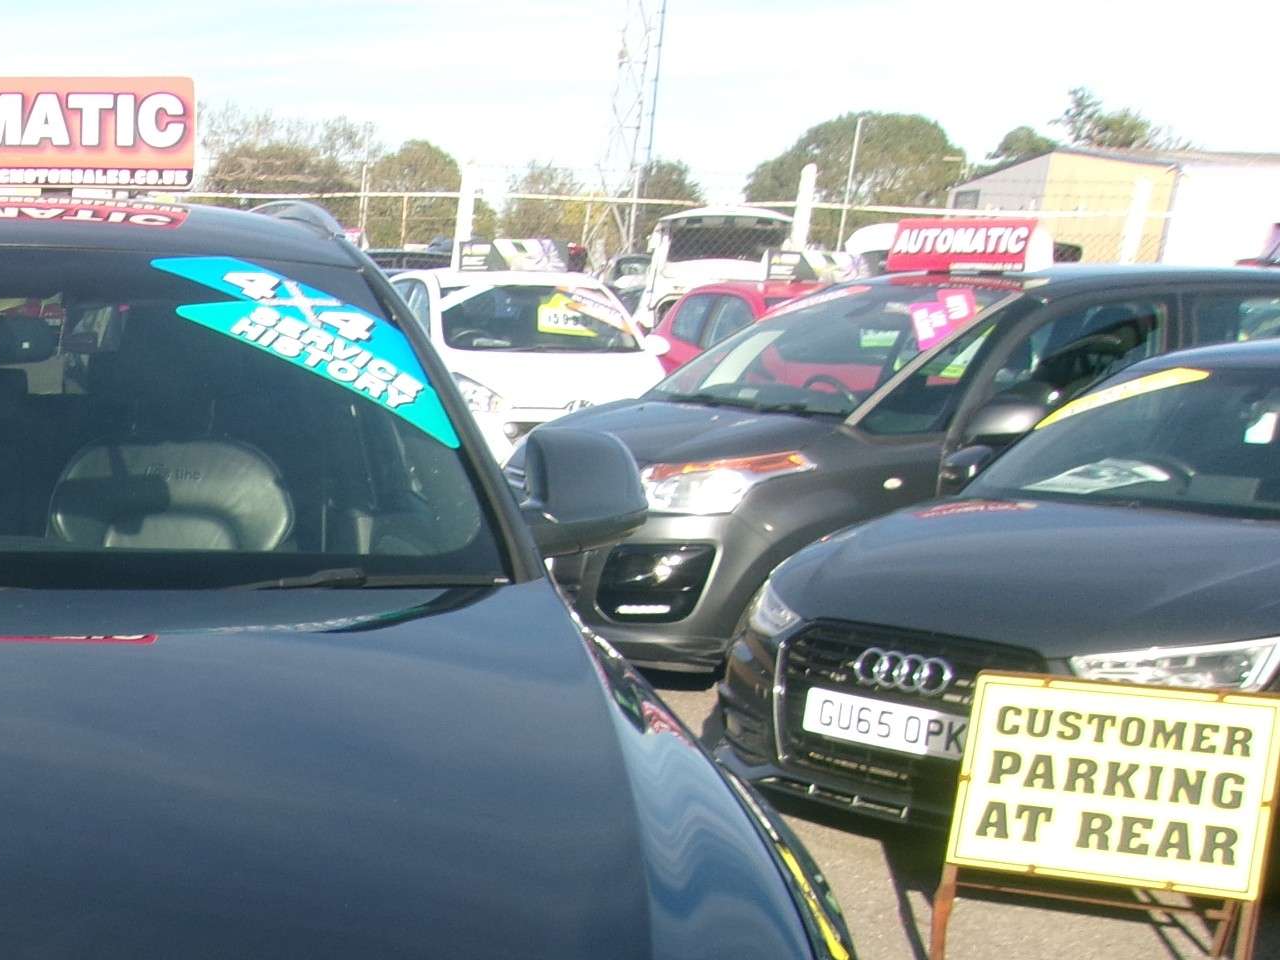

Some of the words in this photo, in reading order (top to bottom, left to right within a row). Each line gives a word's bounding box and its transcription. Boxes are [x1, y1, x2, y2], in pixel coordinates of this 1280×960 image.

[893, 227, 1029, 254] AUTOMATIC
[230, 317, 417, 408] HISTORY
[249, 306, 424, 398] SERVICE
[820, 699, 894, 738] GU65
[904, 715, 967, 753] OPK
[996, 705, 1253, 757] CUSTOMER
[988, 750, 1246, 810] PARKING
[976, 801, 1054, 843] AT
[1076, 812, 1239, 866] REAR
